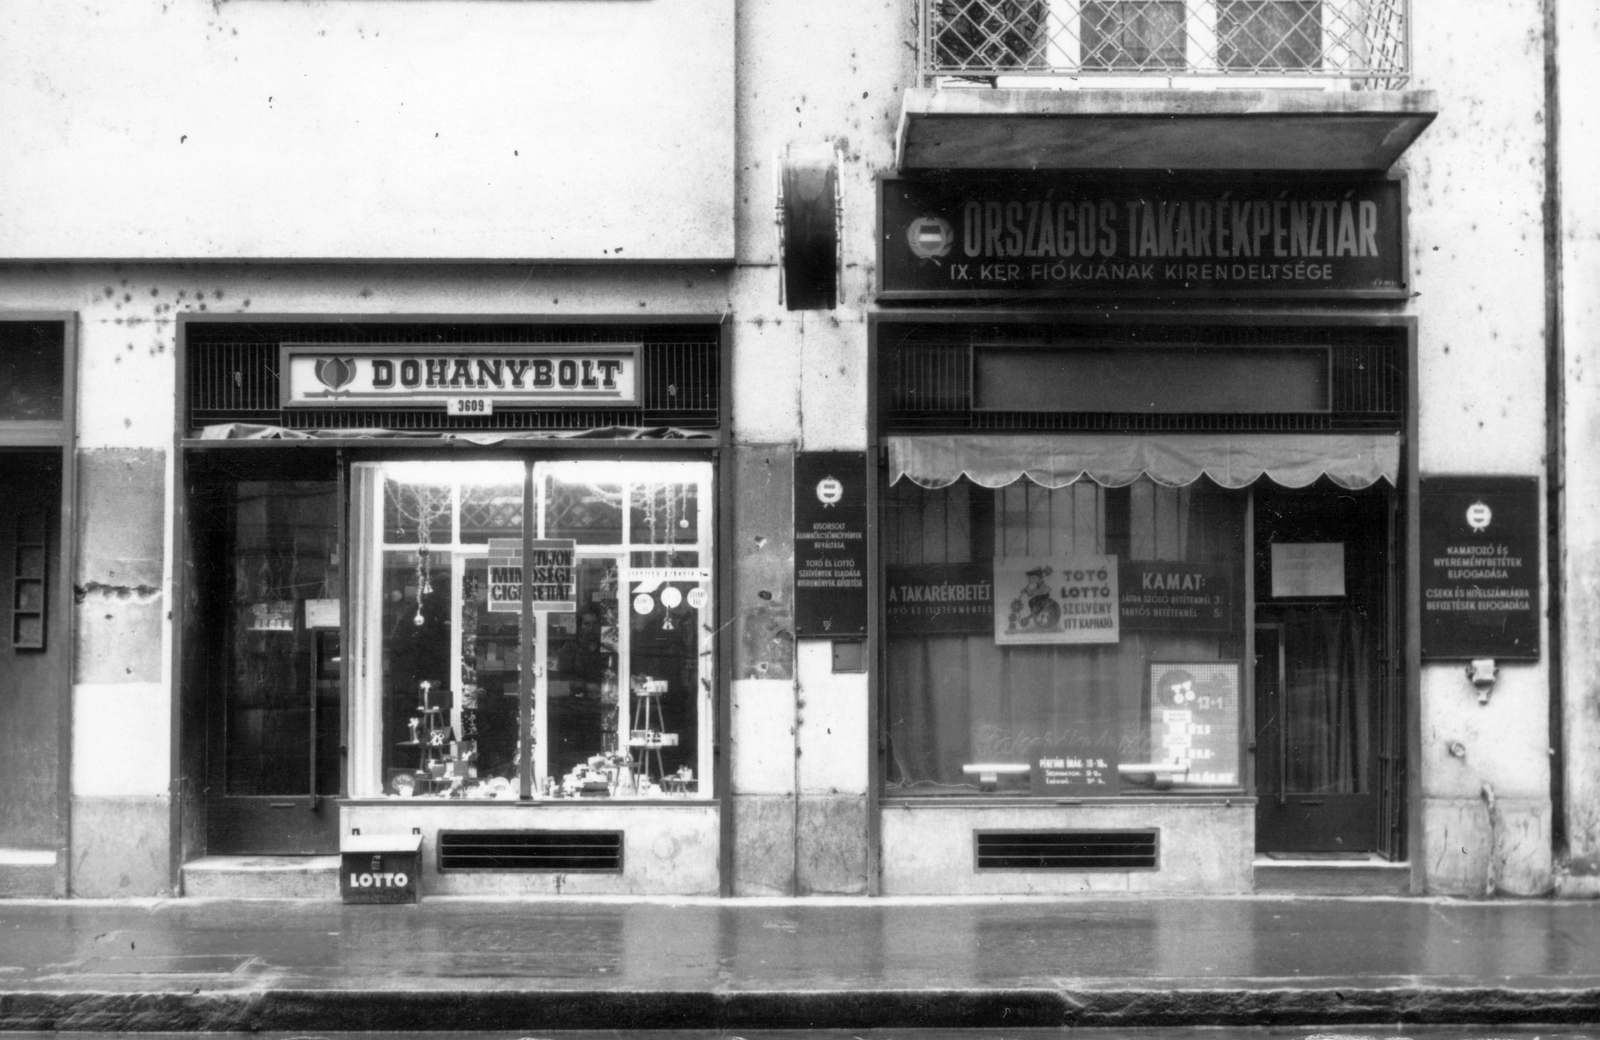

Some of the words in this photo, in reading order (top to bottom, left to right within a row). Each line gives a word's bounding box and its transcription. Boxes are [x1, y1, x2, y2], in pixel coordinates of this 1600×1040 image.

[963, 191, 1117, 257] ORSZÁGOS
[1127, 190, 1379, 257] TAKARÉKPÉNZTÁR
[950, 264, 973, 280] IX.
[980, 264, 1024, 280] KER.
[1031, 259, 1153, 280] FIÓKJÁNAK
[1165, 260, 1333, 280] KIRENDELTSÉGE
[458, 399, 485, 411] 3609
[813, 522, 846, 530] KISORSOLT
[814, 540, 845, 549] BEVÁLTÁSA
[1447, 543, 1495, 555] KAMATOZÓ
[1497, 543, 1508, 555] ÉS
[806, 558, 823, 568] TOTÓ
[825, 558, 832, 568] ÉS
[834, 558, 855, 568] LOTTÓ
[1434, 555, 1522, 567] NYEREMÉNYBETÉTEK
[492, 566, 571, 583] MINSÉGI
[798, 568, 832, 577] SZELVÉNYEK
[834, 567, 861, 577] ELADÁSA
[1063, 566, 1108, 582] TOTÓ
[1448, 567, 1508, 579] ELFOGADÁSA
[797, 578, 835, 587] NYEREMÉNYEK
[1142, 573, 1206, 590] KAMAT:
[889, 586, 897, 601] A
[900, 581, 991, 601] TAKARÉKBETÉT
[1061, 583, 1110, 598] LOTTÓ
[1426, 588, 1453, 598] CSEKK
[1455, 586, 1465, 598] ÉS
[1466, 586, 1530, 598] HITELSZÁMLÁKRA
[1143, 592, 1169, 603] SZÓLÓ
[1171, 593, 1211, 604] BETÉTEKNÉL
[887, 604, 907, 614] ADÓ
[911, 604, 921, 614] ÉS
[1063, 601, 1112, 615] SZELVÉNY
[1122, 605, 1151, 616] TARTÓS
[1426, 599, 1475, 610] BEFIZETÉSEK
[1478, 599, 1530, 610] ELFOGADÁSA
[1064, 618, 1077, 629] ITT
[1079, 616, 1113, 629] KAPHATÓ
[350, 872, 408, 887] LOTTO
